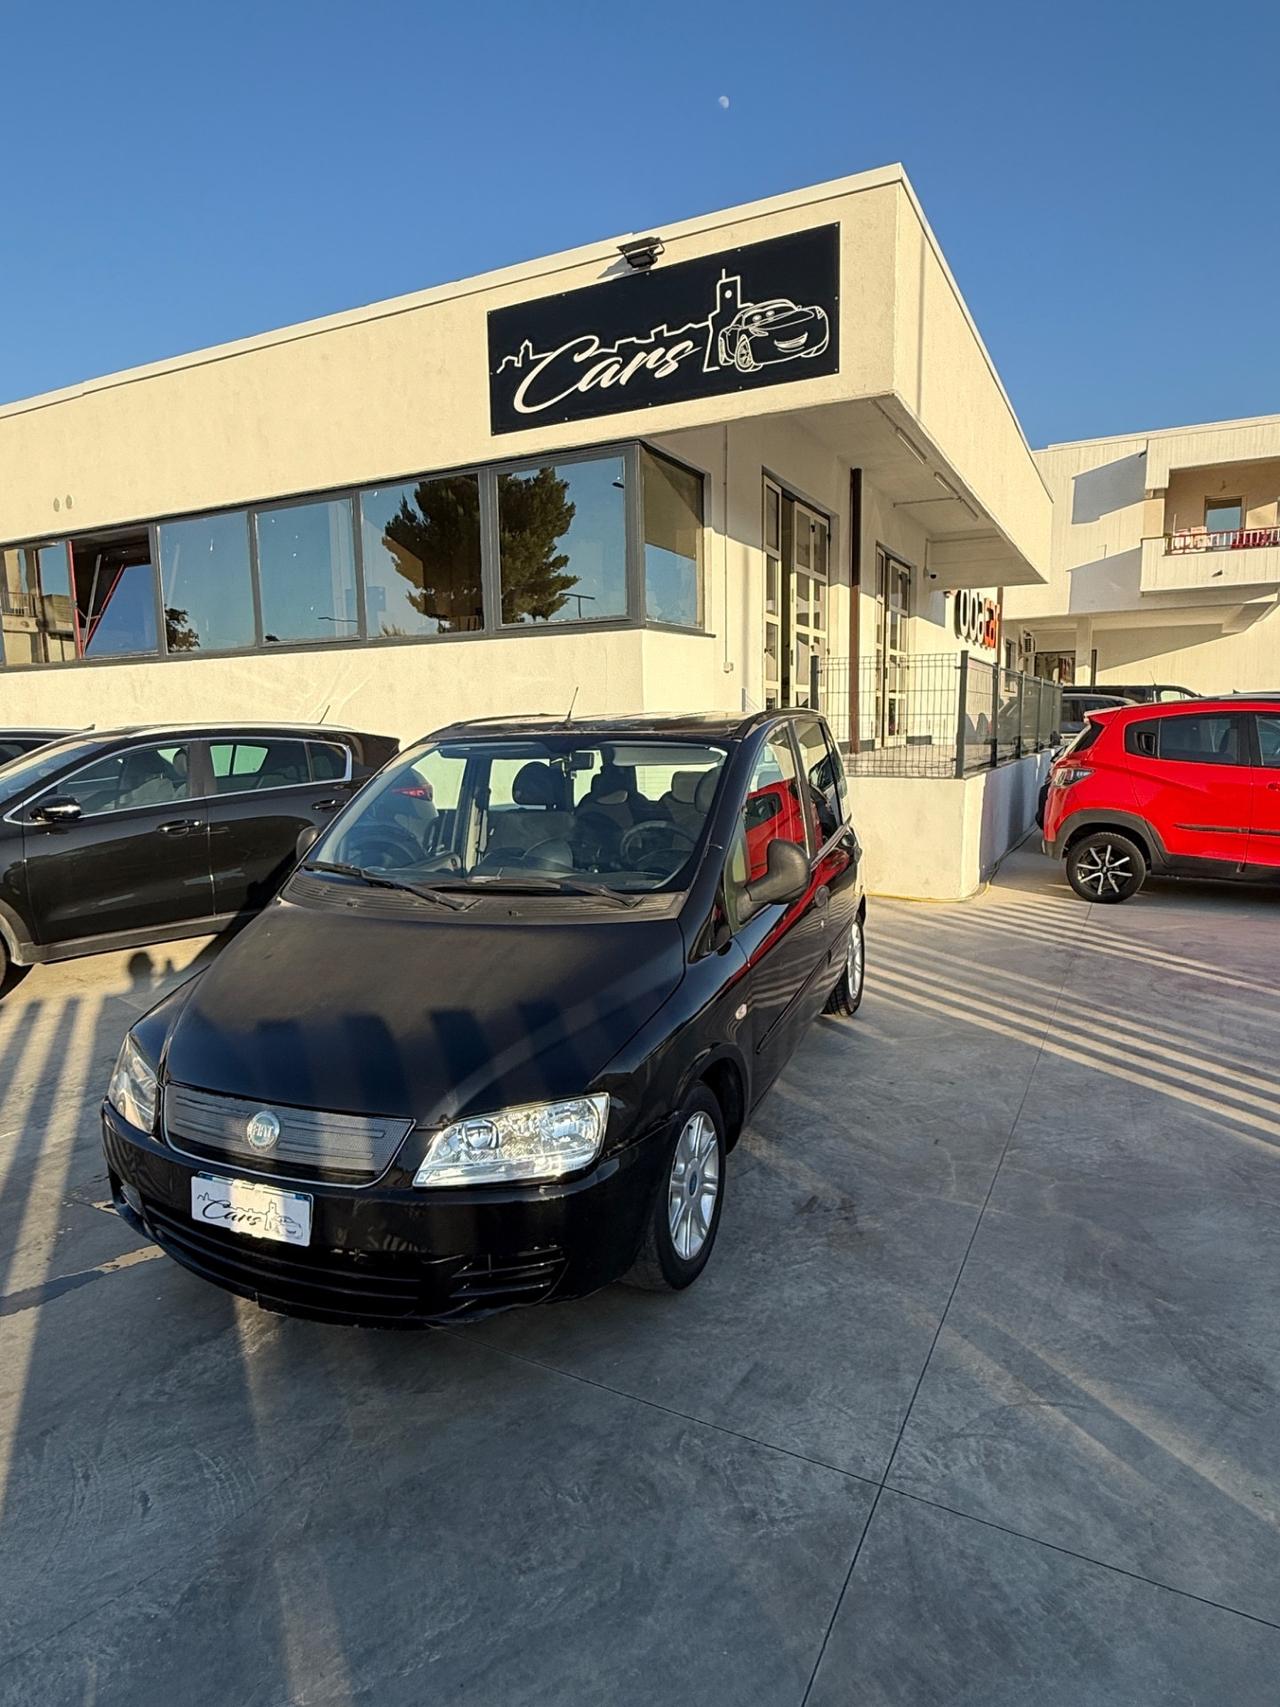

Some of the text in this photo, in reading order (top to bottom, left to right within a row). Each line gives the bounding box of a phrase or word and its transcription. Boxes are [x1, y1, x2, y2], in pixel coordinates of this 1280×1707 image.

[513, 335, 702, 414] Cars
[252, 1122, 274, 1138] FIAT
[202, 1200, 262, 1226] Cars
